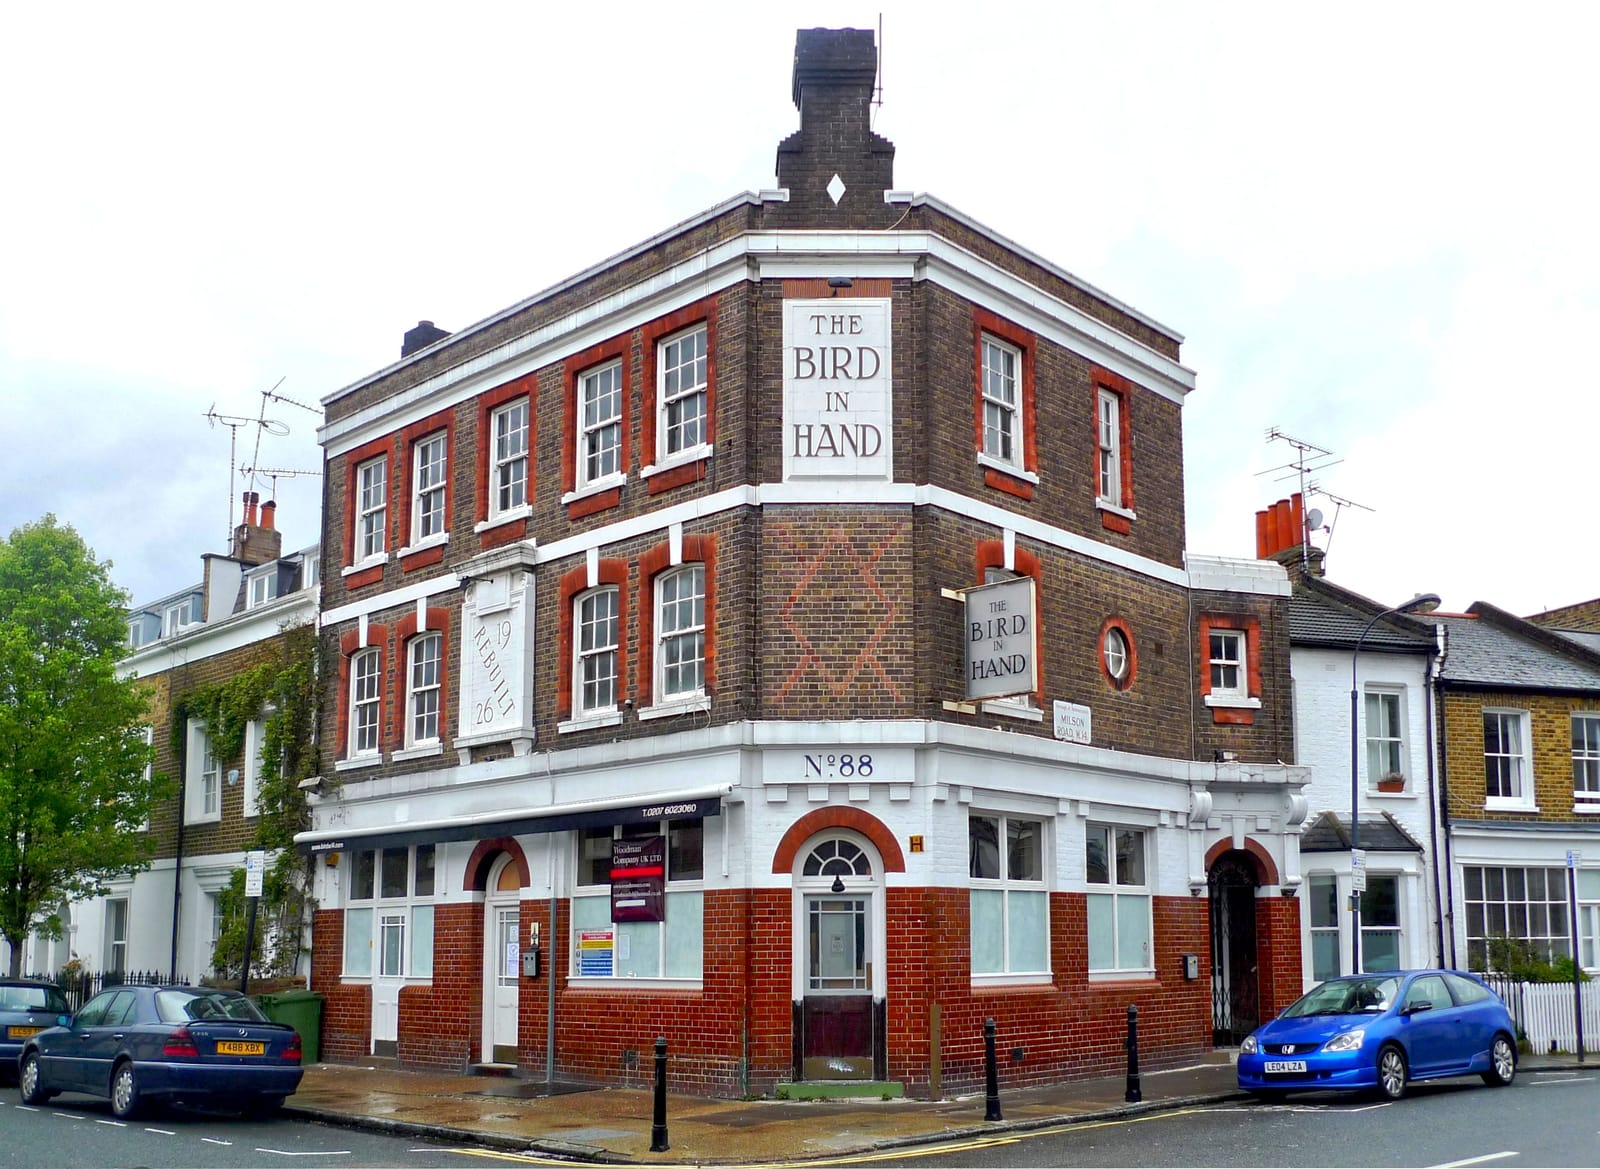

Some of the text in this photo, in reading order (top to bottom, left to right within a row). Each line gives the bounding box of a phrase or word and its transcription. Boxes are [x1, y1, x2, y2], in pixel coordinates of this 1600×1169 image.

[809, 315, 863, 335] THE
[793, 347, 880, 380] BIRD
[825, 391, 849, 412] IN
[793, 424, 882, 457] HAND
[989, 600, 1007, 613] THE
[497, 620, 512, 649] 19
[971, 614, 1026, 642] BIRD
[993, 640, 1003, 651] IN
[474, 625, 516, 717] REBUILT
[971, 654, 1026, 680] HAND
[476, 696, 494, 725] 26
[1060, 714, 1085, 728] MILSON
[840, 754, 873, 777] 88
[613, 855, 639, 866] Company
[640, 855, 649, 863] UK
[1287, 1062, 1303, 1071] LZA
